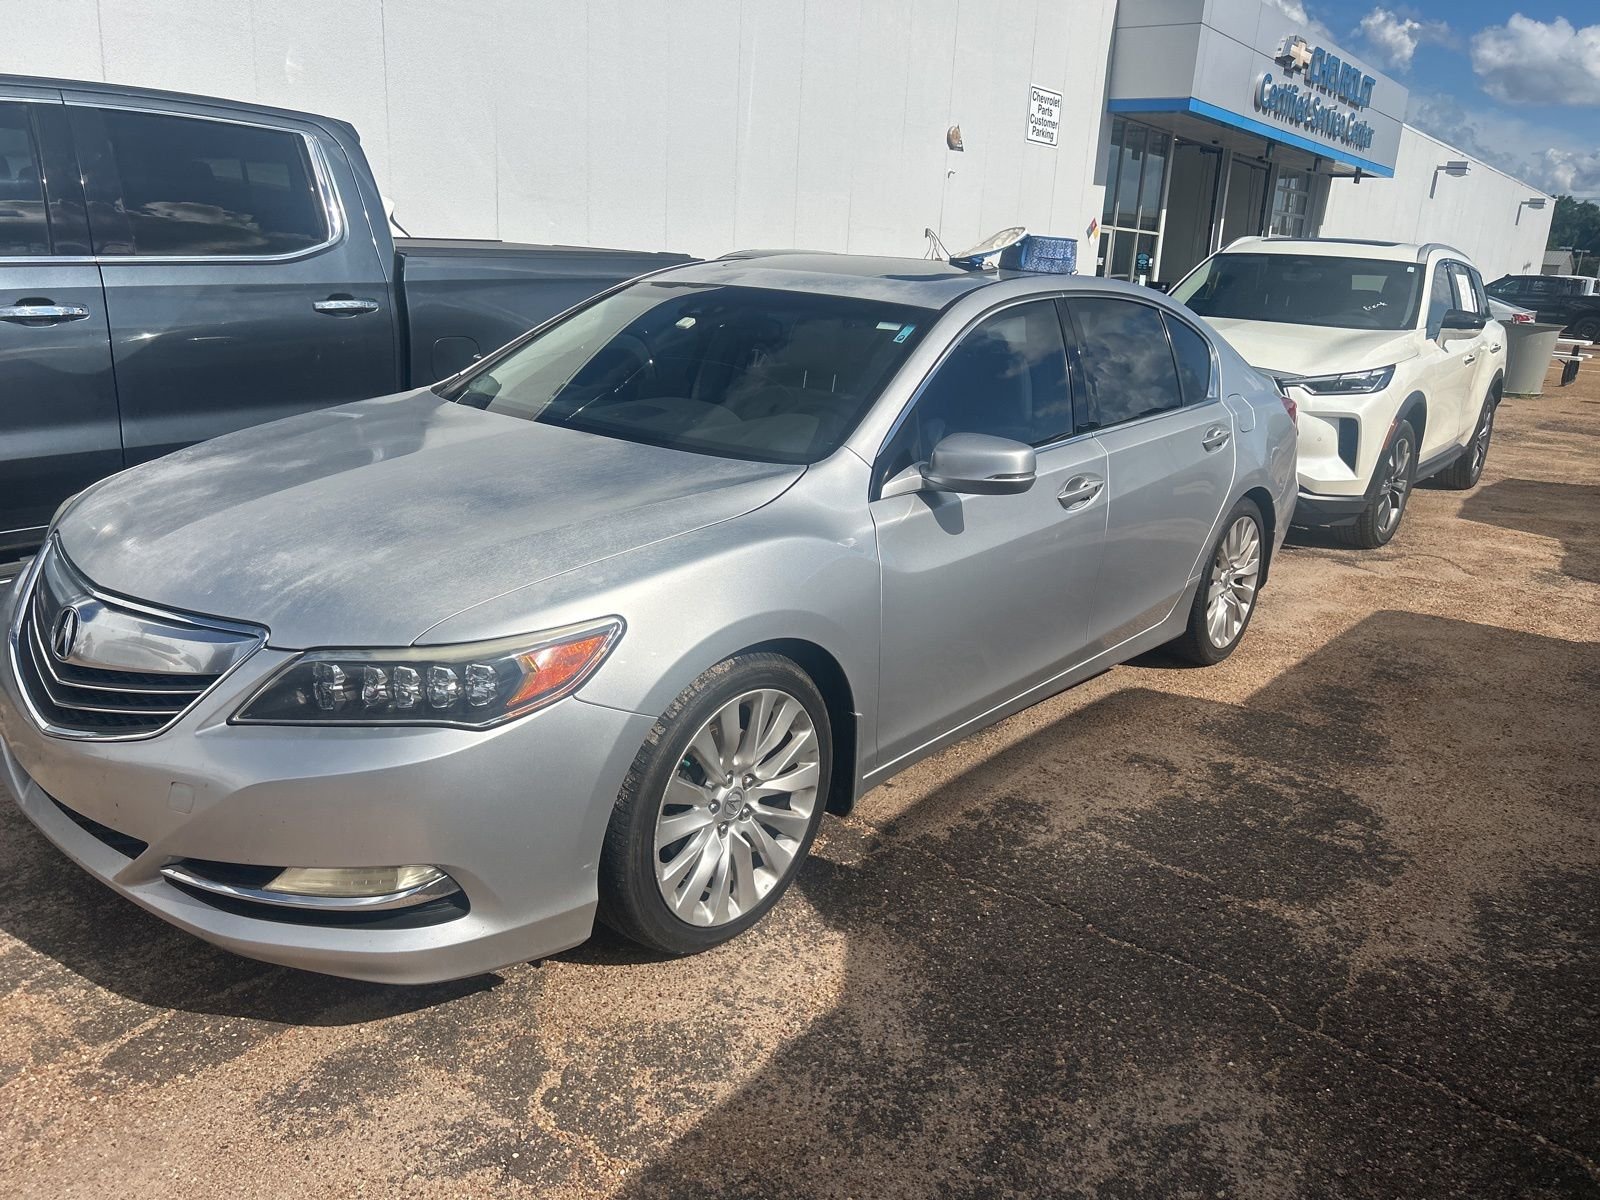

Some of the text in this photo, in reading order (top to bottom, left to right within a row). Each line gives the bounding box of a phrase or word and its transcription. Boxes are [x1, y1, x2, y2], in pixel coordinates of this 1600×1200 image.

[1308, 46, 1376, 109] CHEVROLET
[1032, 90, 1060, 108] Chevrolet
[1037, 104, 1053, 117] Parts
[1257, 73, 1375, 149] Certified Service Center
[1030, 113, 1058, 129] Customer
[1032, 125, 1054, 142] Parking
